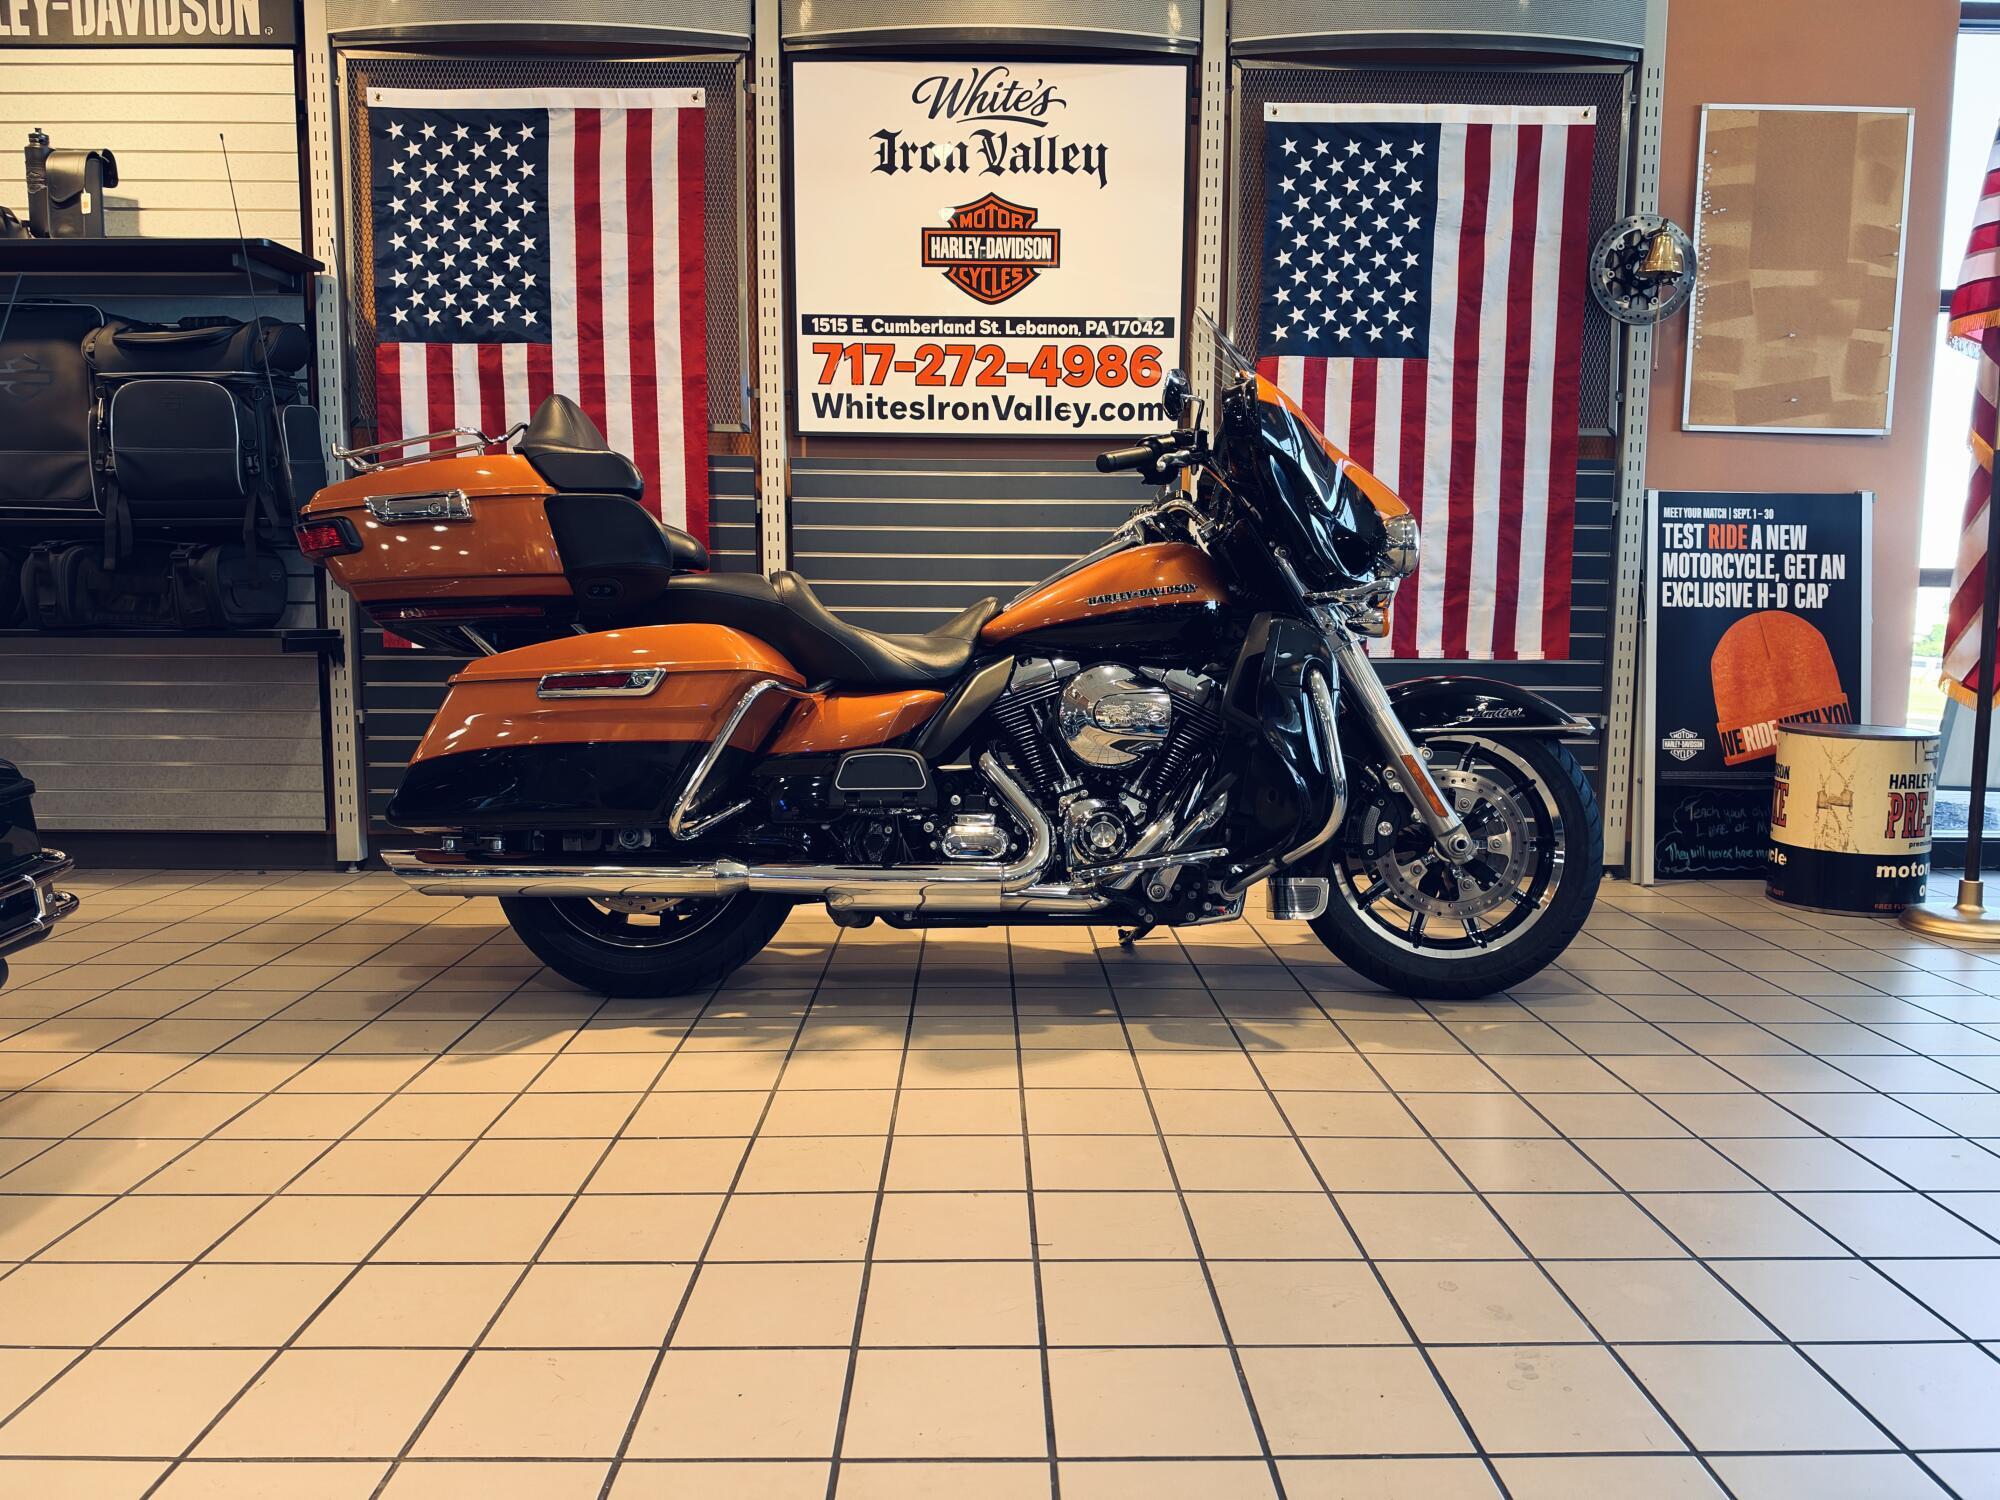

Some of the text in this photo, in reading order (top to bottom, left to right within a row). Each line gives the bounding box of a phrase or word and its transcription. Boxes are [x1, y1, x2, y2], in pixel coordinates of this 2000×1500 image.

[912, 66, 1067, 120] White's
[869, 128, 1109, 189] Iron Valley
[960, 202, 1023, 229] MOTOR
[930, 236, 1052, 260] HARLEY-DAVIDSON
[958, 267, 1023, 296] CYCLES
[811, 317, 1165, 337] 1515 E. Cumberland St. Lebanon, PA 17042
[811, 342, 1163, 388] 717-272-4986
[811, 392, 1165, 428] WhitesIronValley.com
[1663, 507, 1683, 519] MEET
[1684, 508, 1702, 519] YOUR
[1703, 508, 1727, 519] MATCH
[1732, 508, 1752, 520] SEPT.
[1753, 508, 1758, 520] 1
[1764, 509, 1774, 520] 30
[1662, 523, 1808, 550] TEST RIDE A NEW
[1662, 552, 1846, 582] MOTORCYCLE, GET AN
[1087, 583, 1197, 606] HARLEY-DAVIDSON
[1662, 582, 1753, 608] EXCLUSIVE
[1673, 730, 1694, 739] MOTOR
[1673, 749, 1694, 759] CYCLES
